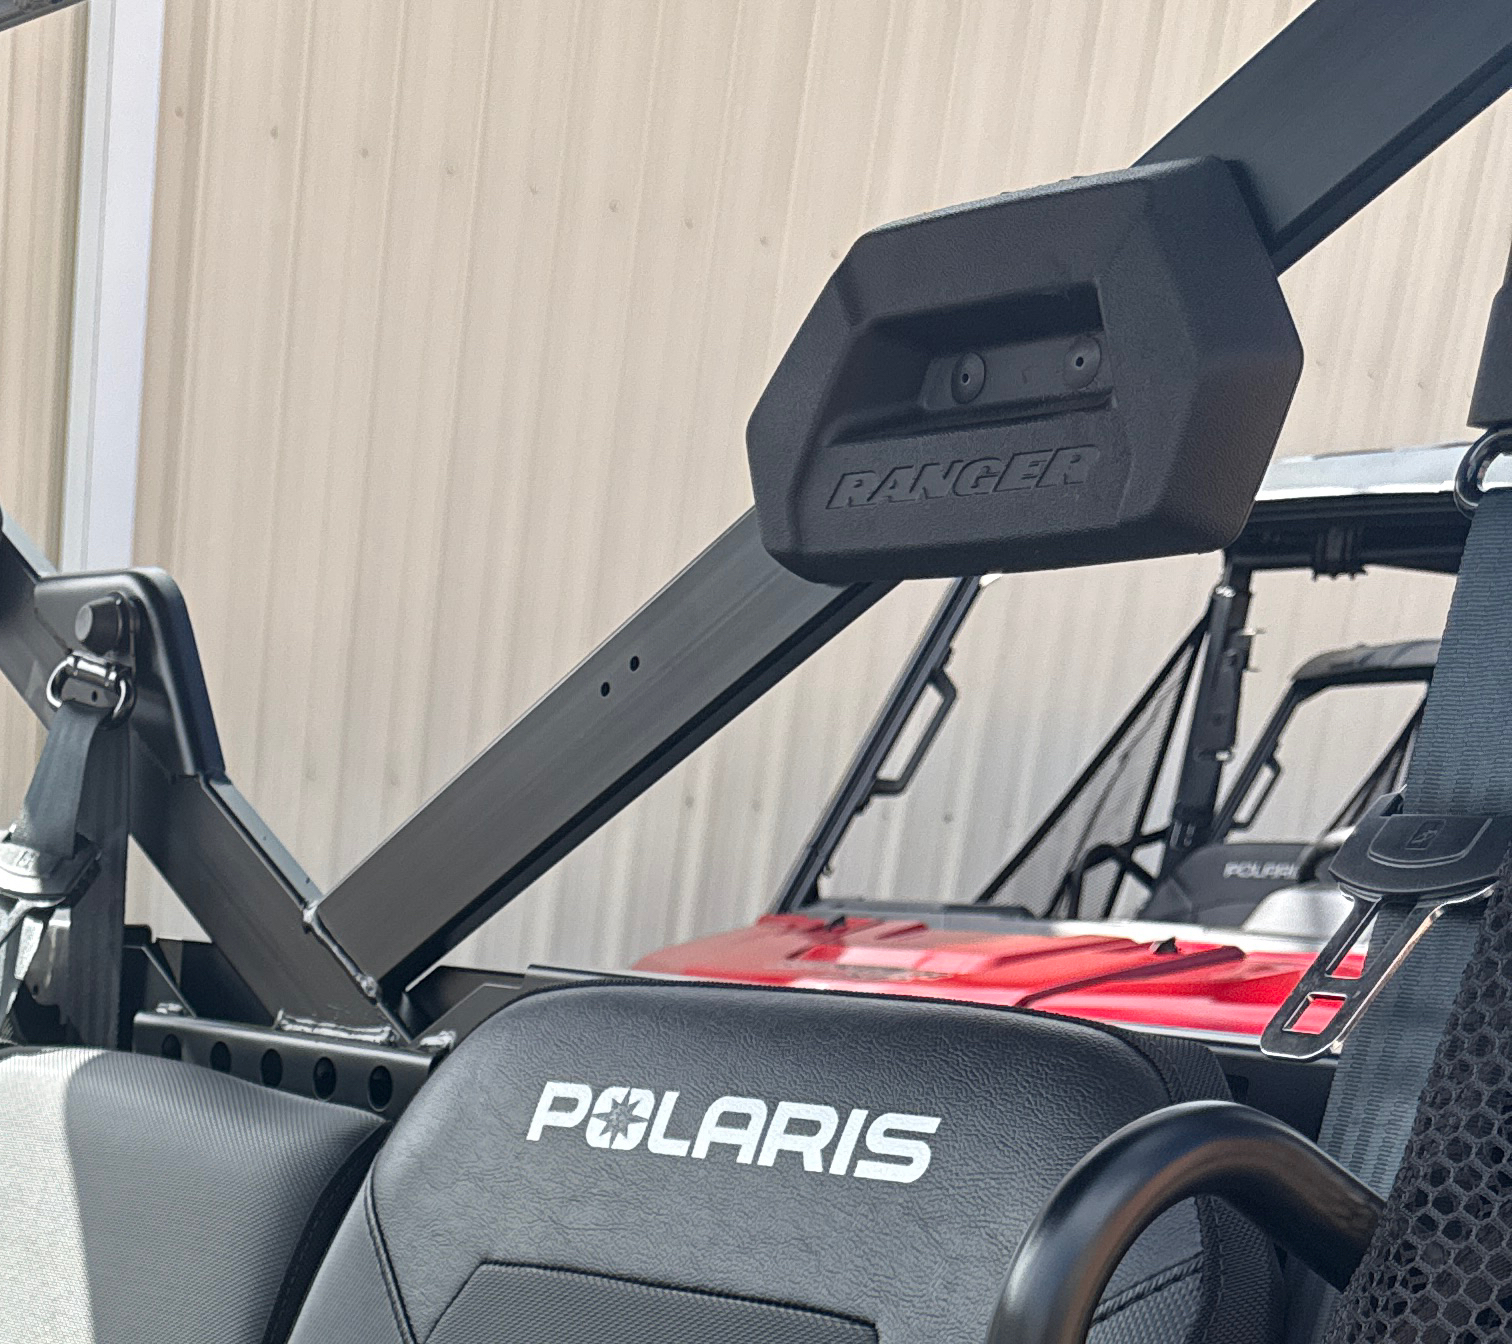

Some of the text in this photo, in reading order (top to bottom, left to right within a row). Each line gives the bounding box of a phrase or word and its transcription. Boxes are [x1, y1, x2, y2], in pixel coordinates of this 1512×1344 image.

[825, 444, 1098, 510] RANGER
[1223, 862, 1299, 880] POLARI
[526, 1081, 942, 1184] POLARIS
